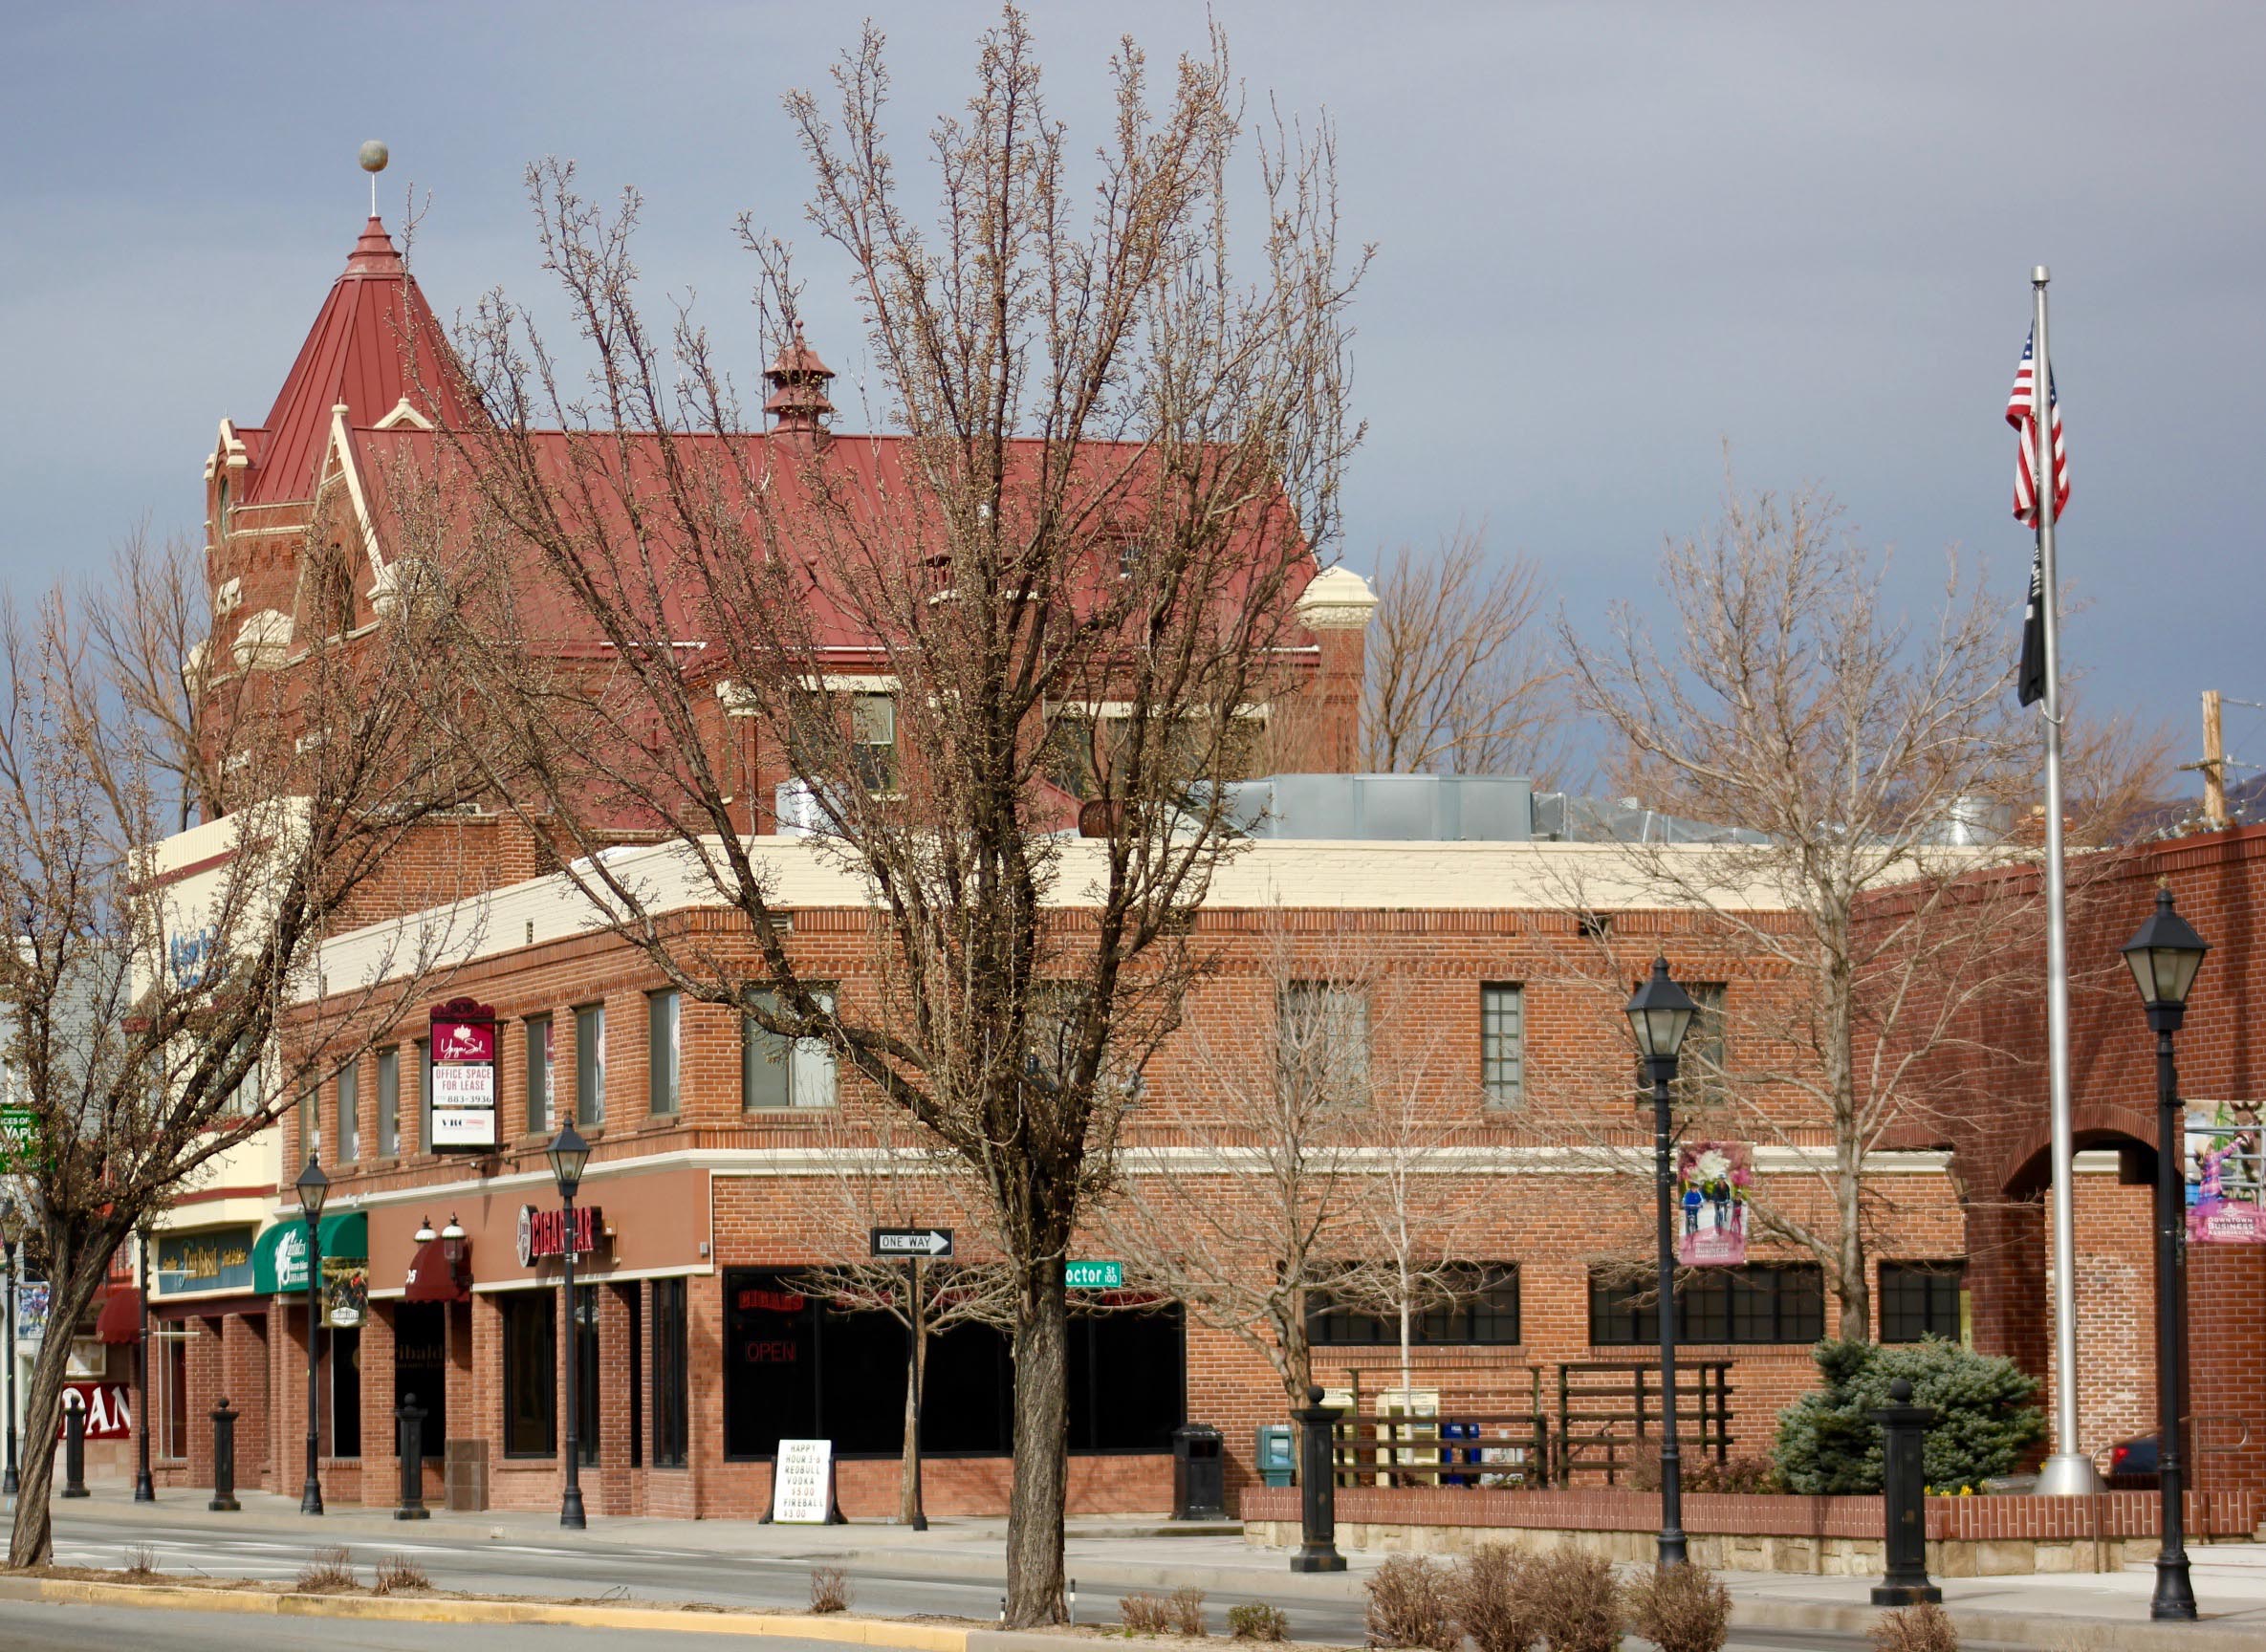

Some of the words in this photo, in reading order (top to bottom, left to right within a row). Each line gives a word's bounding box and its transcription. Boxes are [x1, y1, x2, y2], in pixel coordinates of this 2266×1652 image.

[436, 1068, 462, 1079] OFFICE
[466, 1068, 490, 1079] SPACE
[442, 1080, 457, 1091] FOR
[461, 1080, 485, 1091] LEASE
[447, 1095, 491, 1103] 883-3936
[882, 1236, 904, 1248] ONE
[908, 1236, 931, 1248] WAY
[1105, 1265, 1115, 1274] St
[1104, 1274, 1118, 1283] 100
[748, 1342, 795, 1360] OPEN
[791, 1445, 816, 1453] HAPPY
[786, 1454, 806, 1464] HOUR
[785, 1465, 820, 1474] REDBULL
[787, 1475, 815, 1485] VODKA
[783, 1498, 823, 1508] FIREBALL
